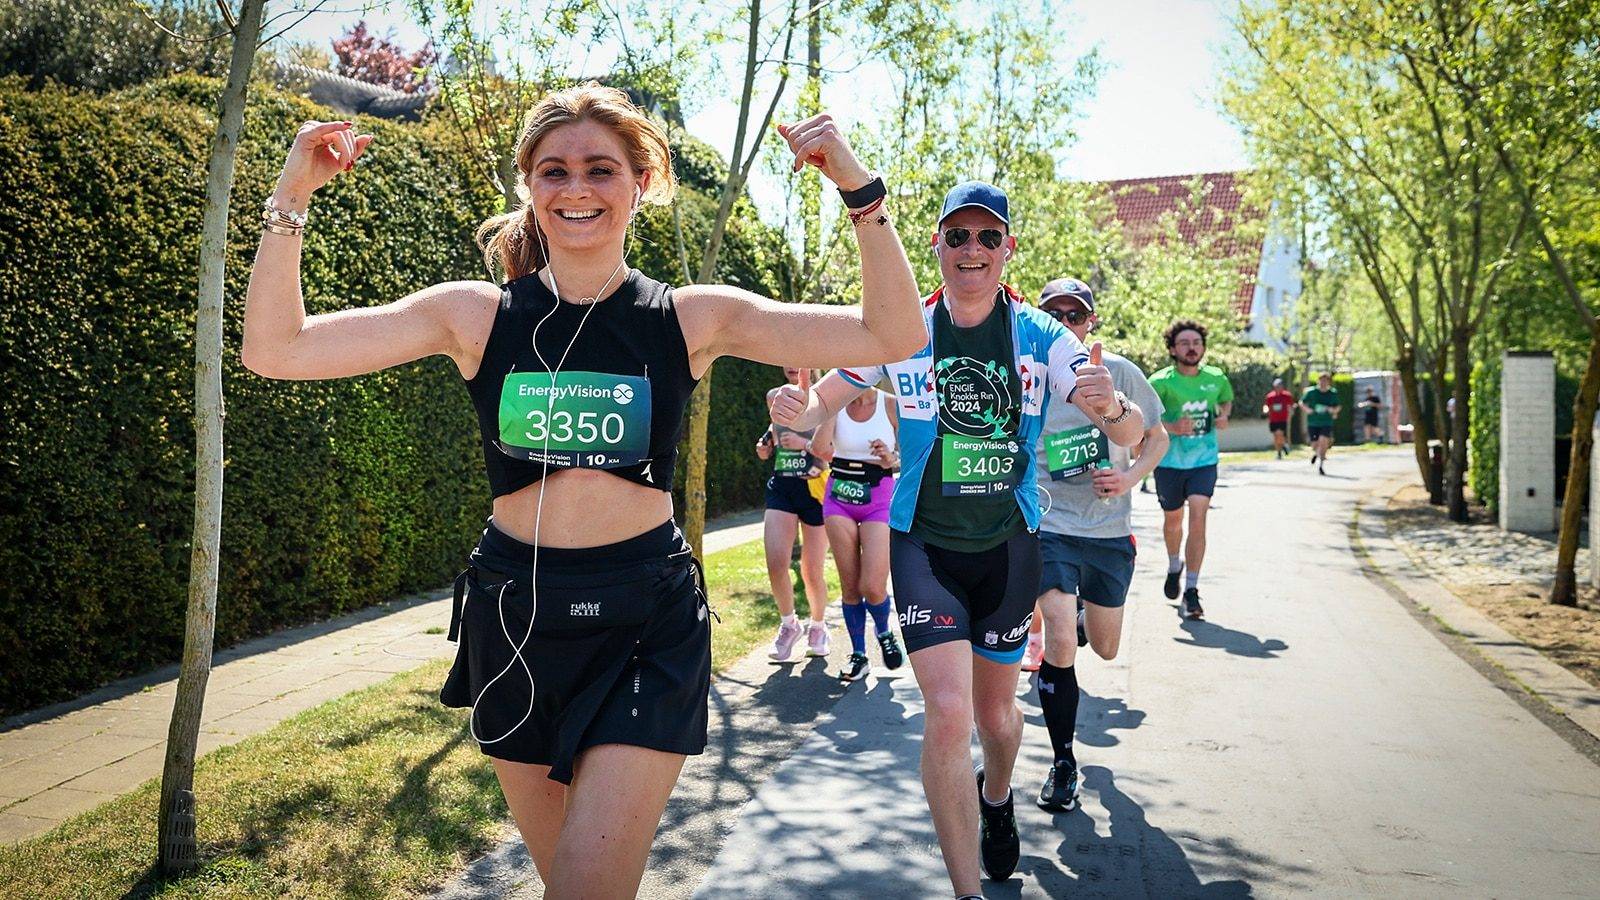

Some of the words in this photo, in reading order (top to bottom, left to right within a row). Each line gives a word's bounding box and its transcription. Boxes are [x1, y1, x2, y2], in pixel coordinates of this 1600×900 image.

[518, 383, 611, 399] EnergyVision
[949, 383, 975, 392] ENGIE
[950, 392, 979, 401] Knokke
[950, 400, 981, 413] 2024
[524, 410, 625, 444] 3350
[1050, 432, 1092, 447] EnergyVision
[953, 441, 1007, 451] EnergyVision
[1059, 441, 1099, 465] 2713
[586, 454, 606, 466] 10
[782, 458, 807, 469] 3469
[957, 456, 1014, 477] 3403
[837, 483, 864, 498] 4005
[993, 482, 1003, 491] 10
[571, 602, 600, 610] rukka
